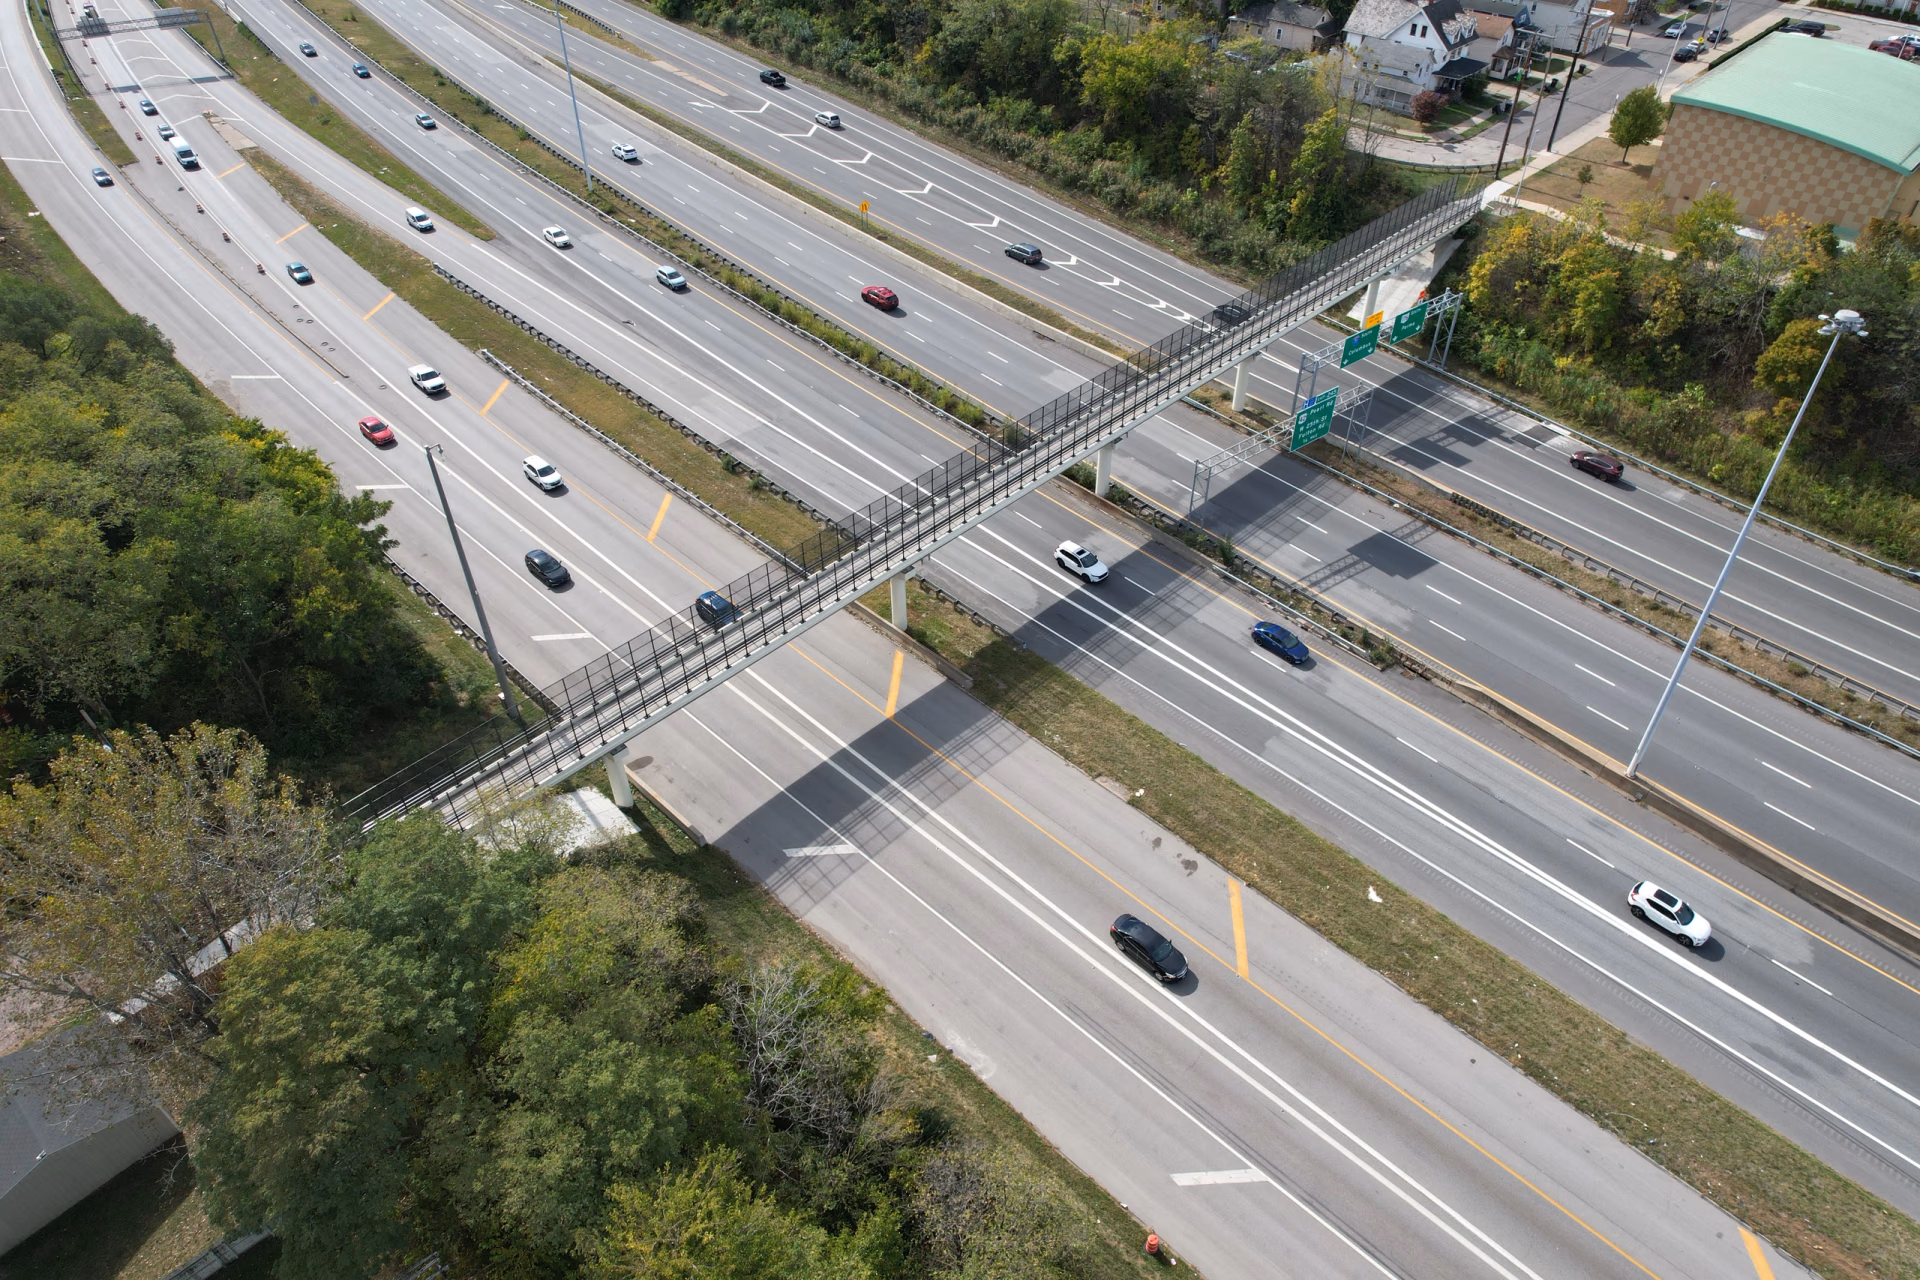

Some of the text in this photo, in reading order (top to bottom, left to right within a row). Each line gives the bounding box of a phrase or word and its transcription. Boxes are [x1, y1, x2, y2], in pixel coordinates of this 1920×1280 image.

[1348, 342, 1371, 356] Columbus
[1310, 405, 1325, 415] Pearl
[1306, 420, 1319, 429] 25th
[1298, 423, 1325, 439] Fulton Rd
